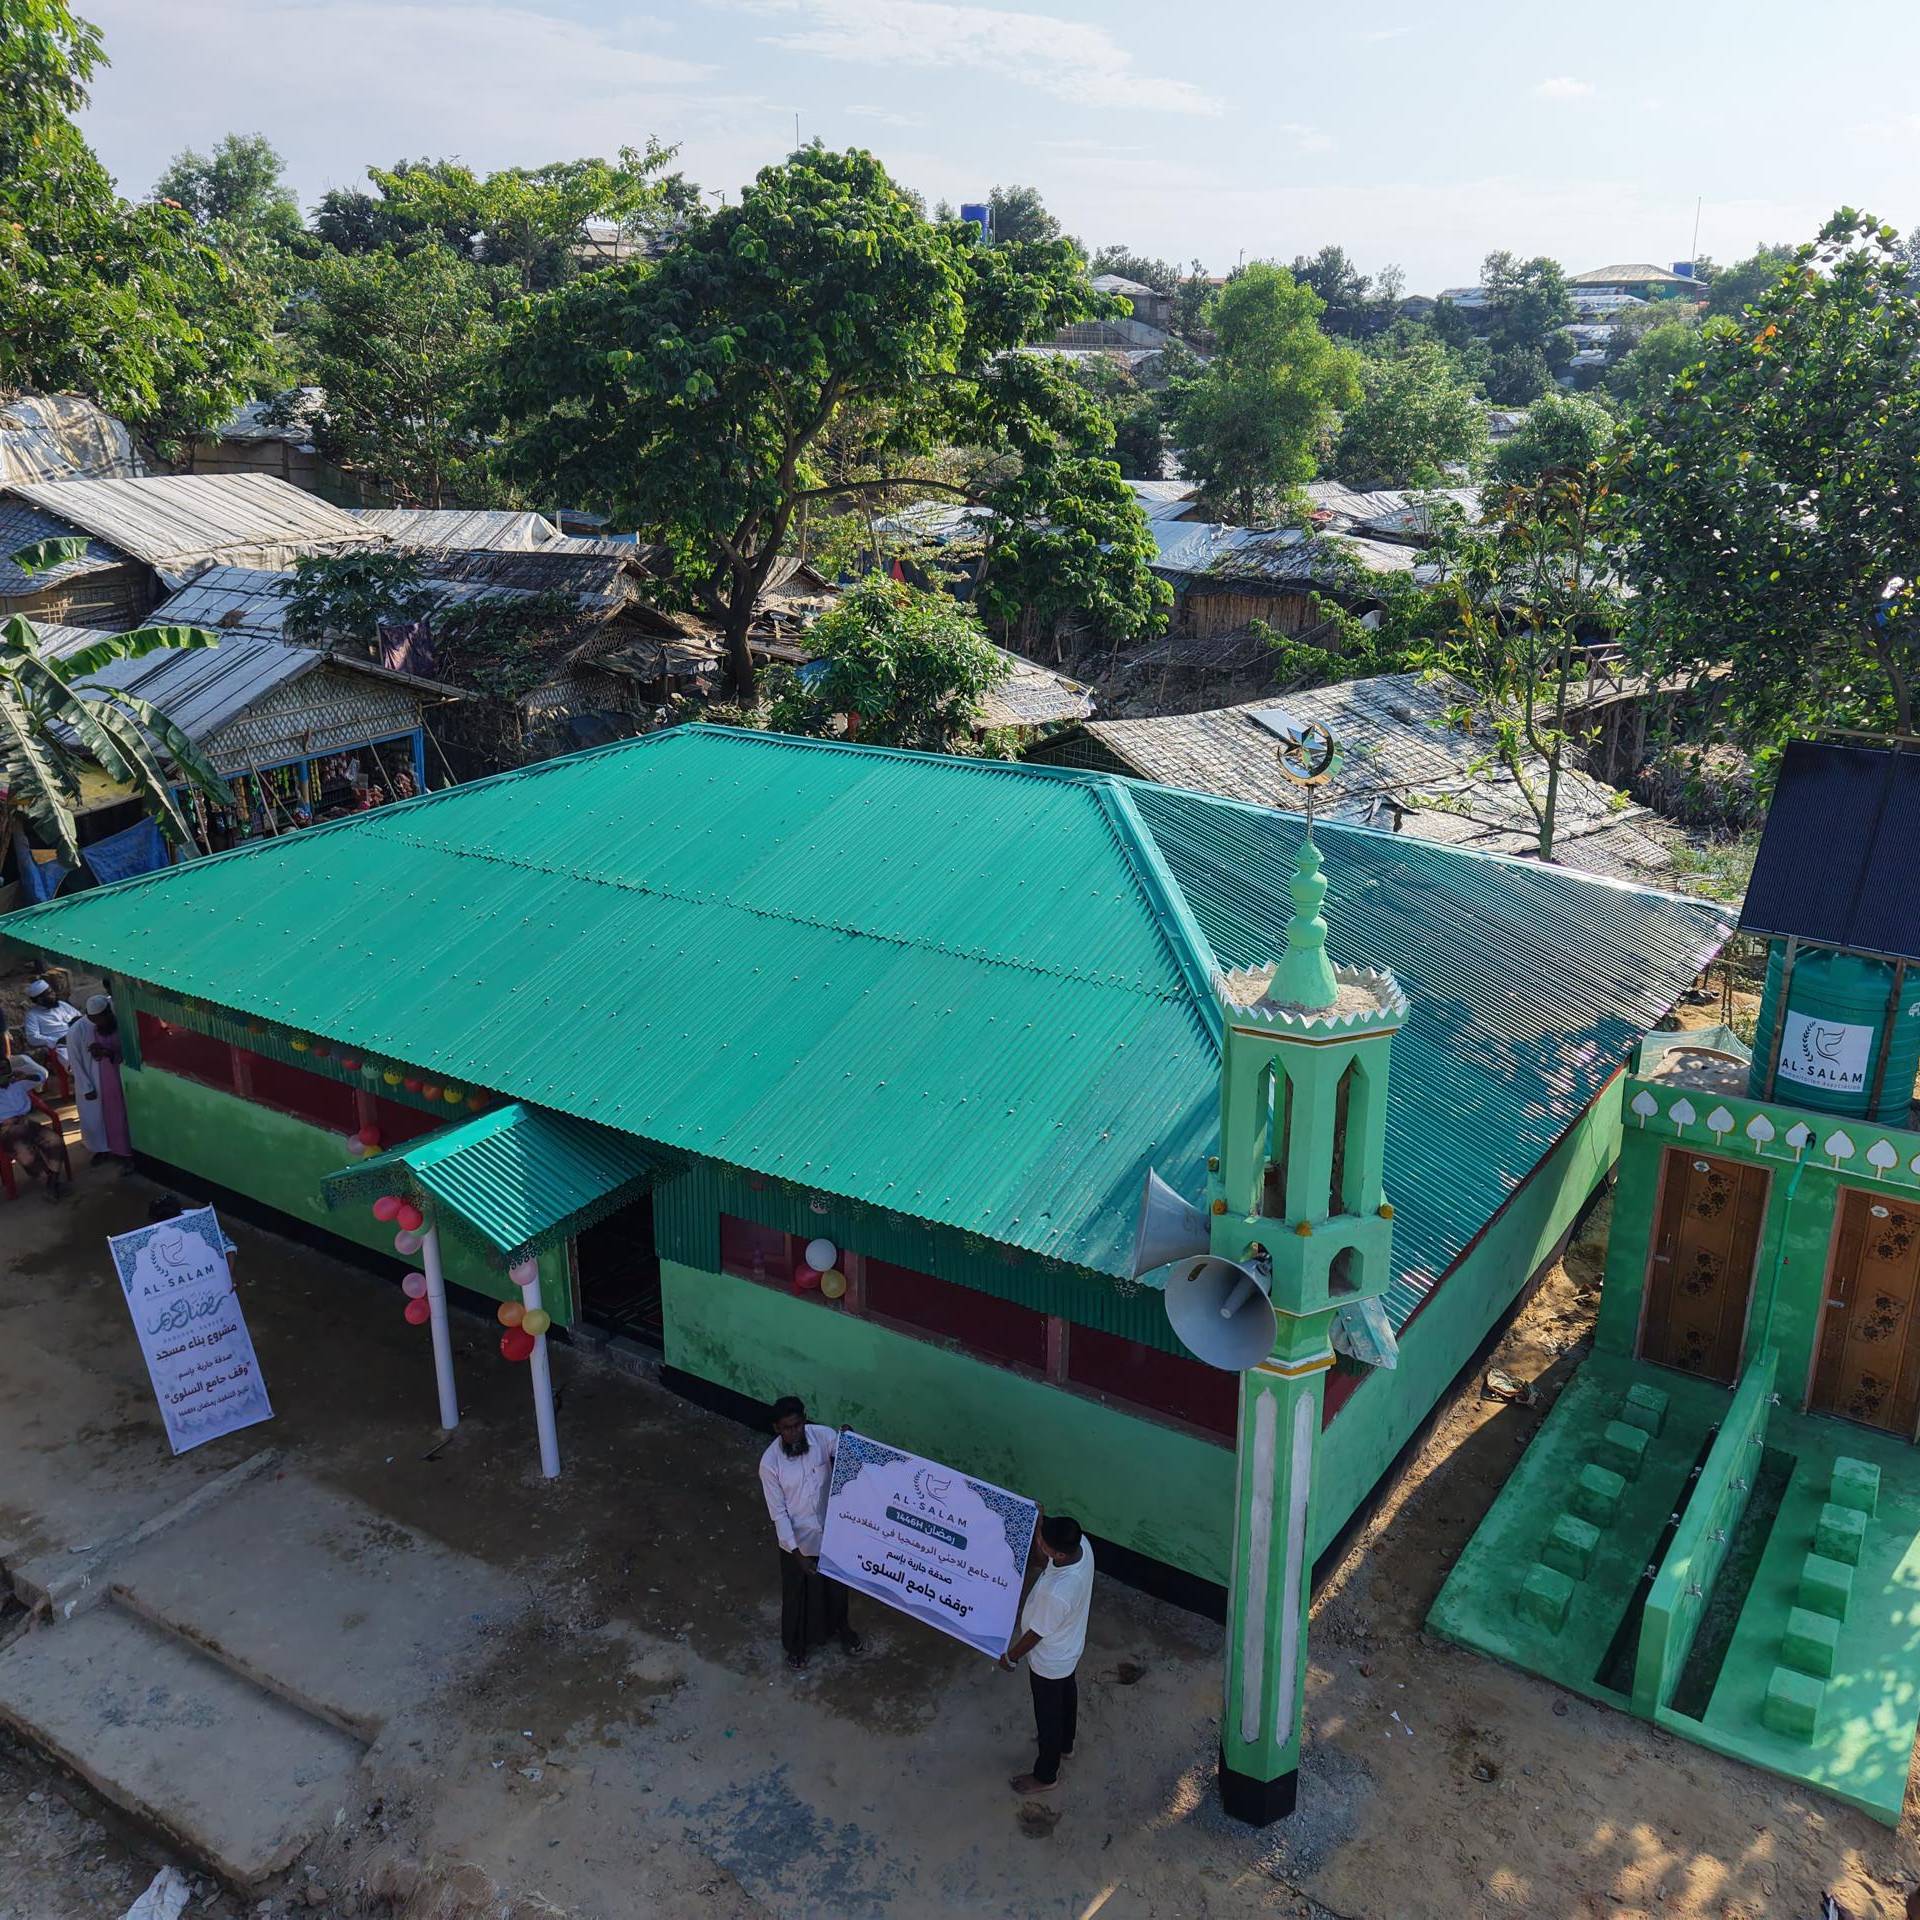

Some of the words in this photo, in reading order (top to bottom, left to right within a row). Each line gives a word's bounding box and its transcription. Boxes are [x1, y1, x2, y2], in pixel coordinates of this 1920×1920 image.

[1782, 1057, 1863, 1083] AL-SALAM
[143, 1263, 214, 1296] AL-SALAM
[188, 1334, 206, 1350] بناء
[206, 1322, 239, 1346] مشروع
[156, 1343, 187, 1361] مسجد
[205, 1373, 227, 1393] جامع
[893, 1491, 968, 1529] AL-SALAM
[895, 1510, 924, 1530] 1446H
[924, 1524, 956, 1545] رمضان
[907, 1558, 928, 1574] جارية
[927, 1566, 953, 1585] صدقة
[966, 1564, 991, 1583] جامع
[905, 1579, 937, 1603] جامع
[991, 1574, 1009, 1591] بناء
